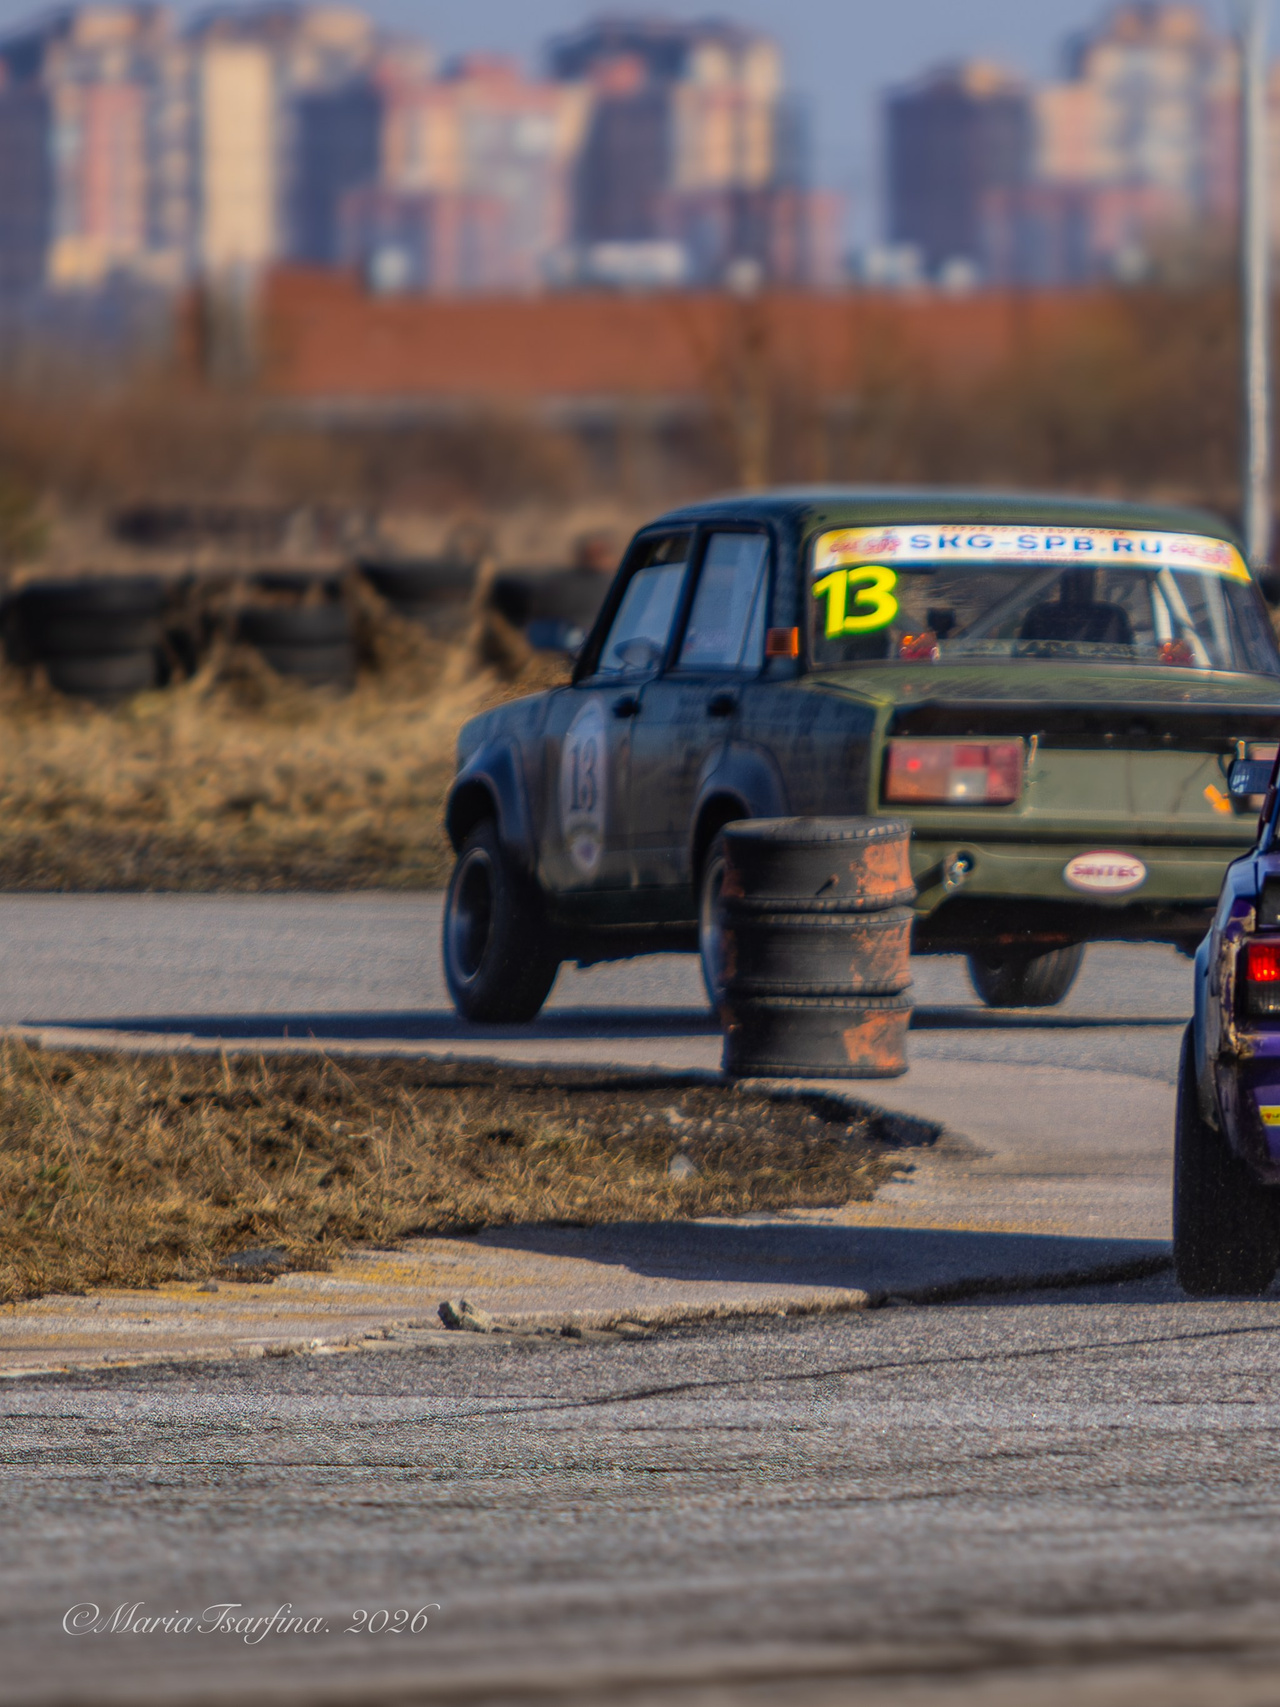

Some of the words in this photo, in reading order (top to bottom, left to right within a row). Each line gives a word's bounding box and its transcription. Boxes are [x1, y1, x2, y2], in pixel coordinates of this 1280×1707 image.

[909, 534, 1162, 553] SKG-SPB.RU
[812, 566, 898, 639] 13
[570, 736, 598, 812] 13
